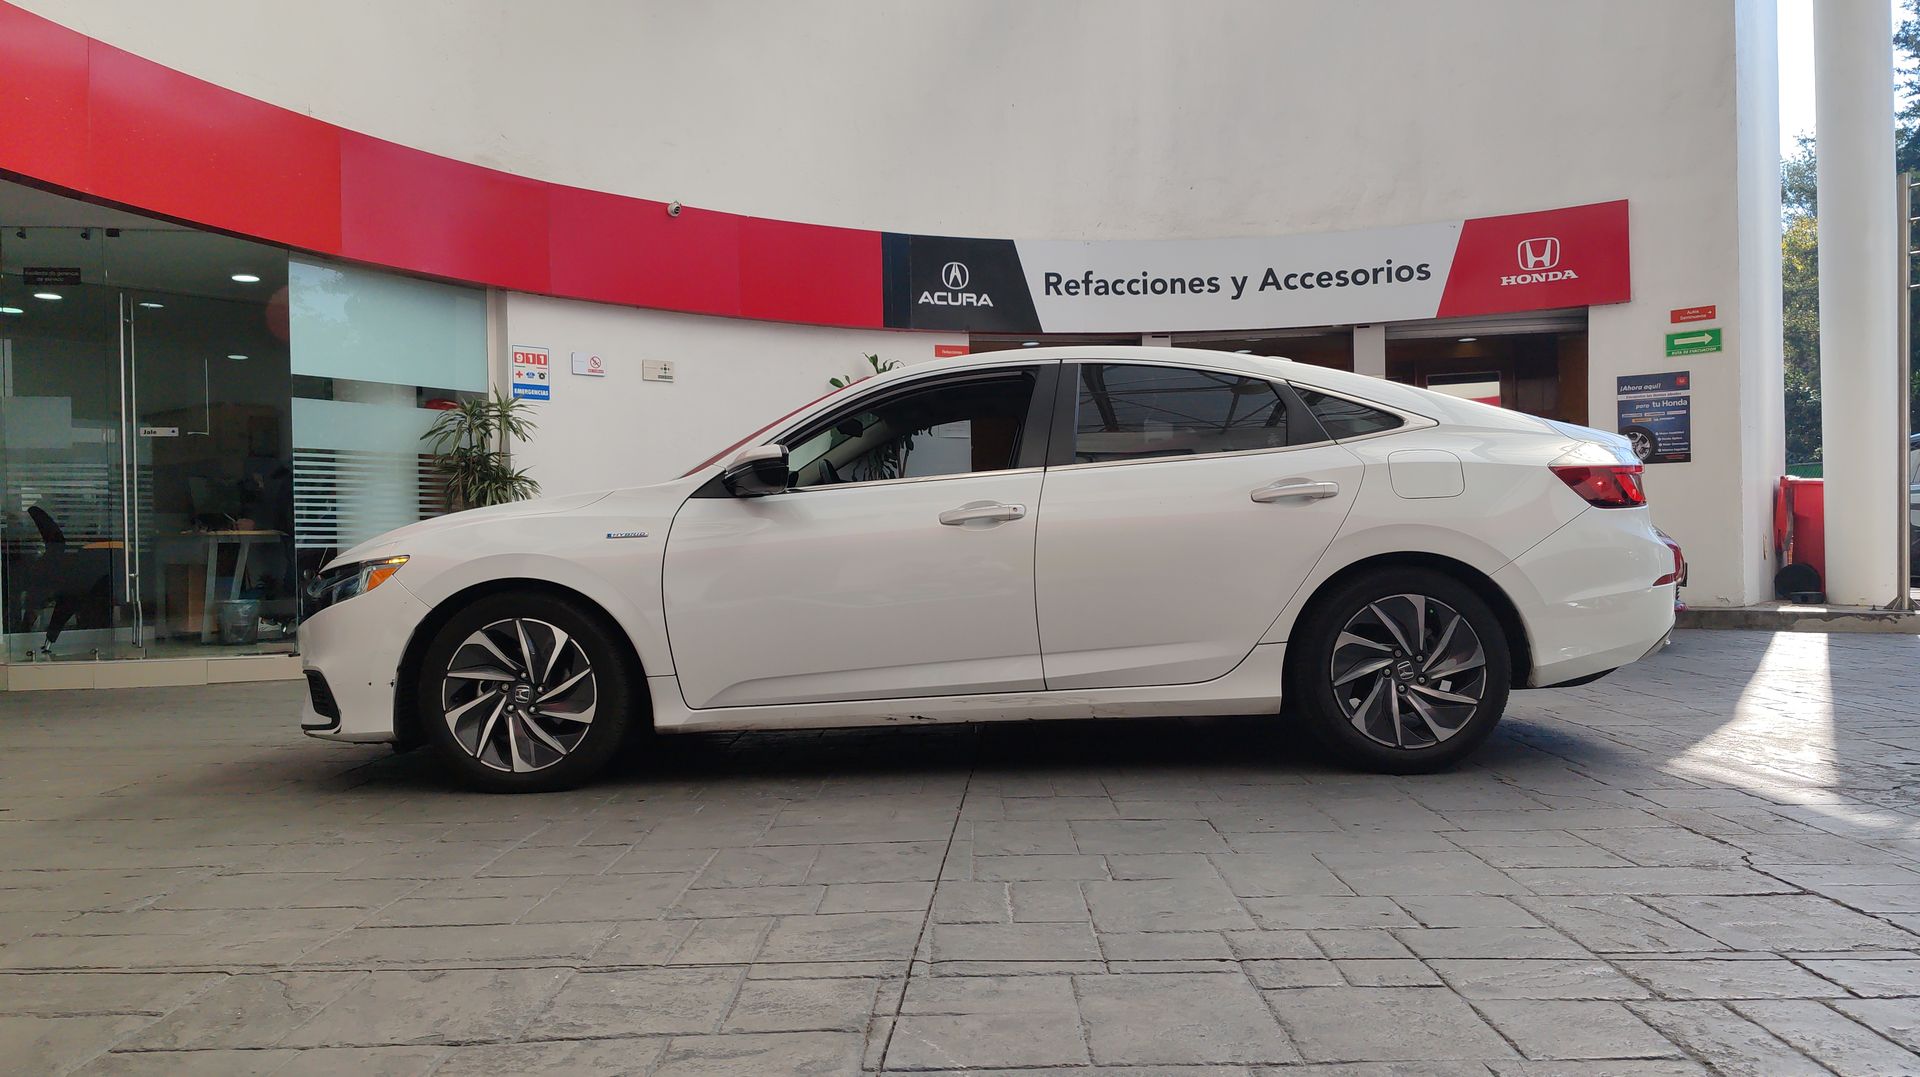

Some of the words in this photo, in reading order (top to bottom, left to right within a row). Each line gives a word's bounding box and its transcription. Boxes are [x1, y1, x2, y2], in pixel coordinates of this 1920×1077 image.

[1044, 271, 1221, 296] Refacciones
[1230, 275, 1248, 300] y
[1258, 259, 1431, 292] Accesorios
[1501, 269, 1579, 286] HONDA
[918, 291, 994, 307] ACURA
[515, 353, 546, 365] 911
[514, 388, 549, 396] EMERGENCIAS
[1662, 398, 1688, 407] Honda
